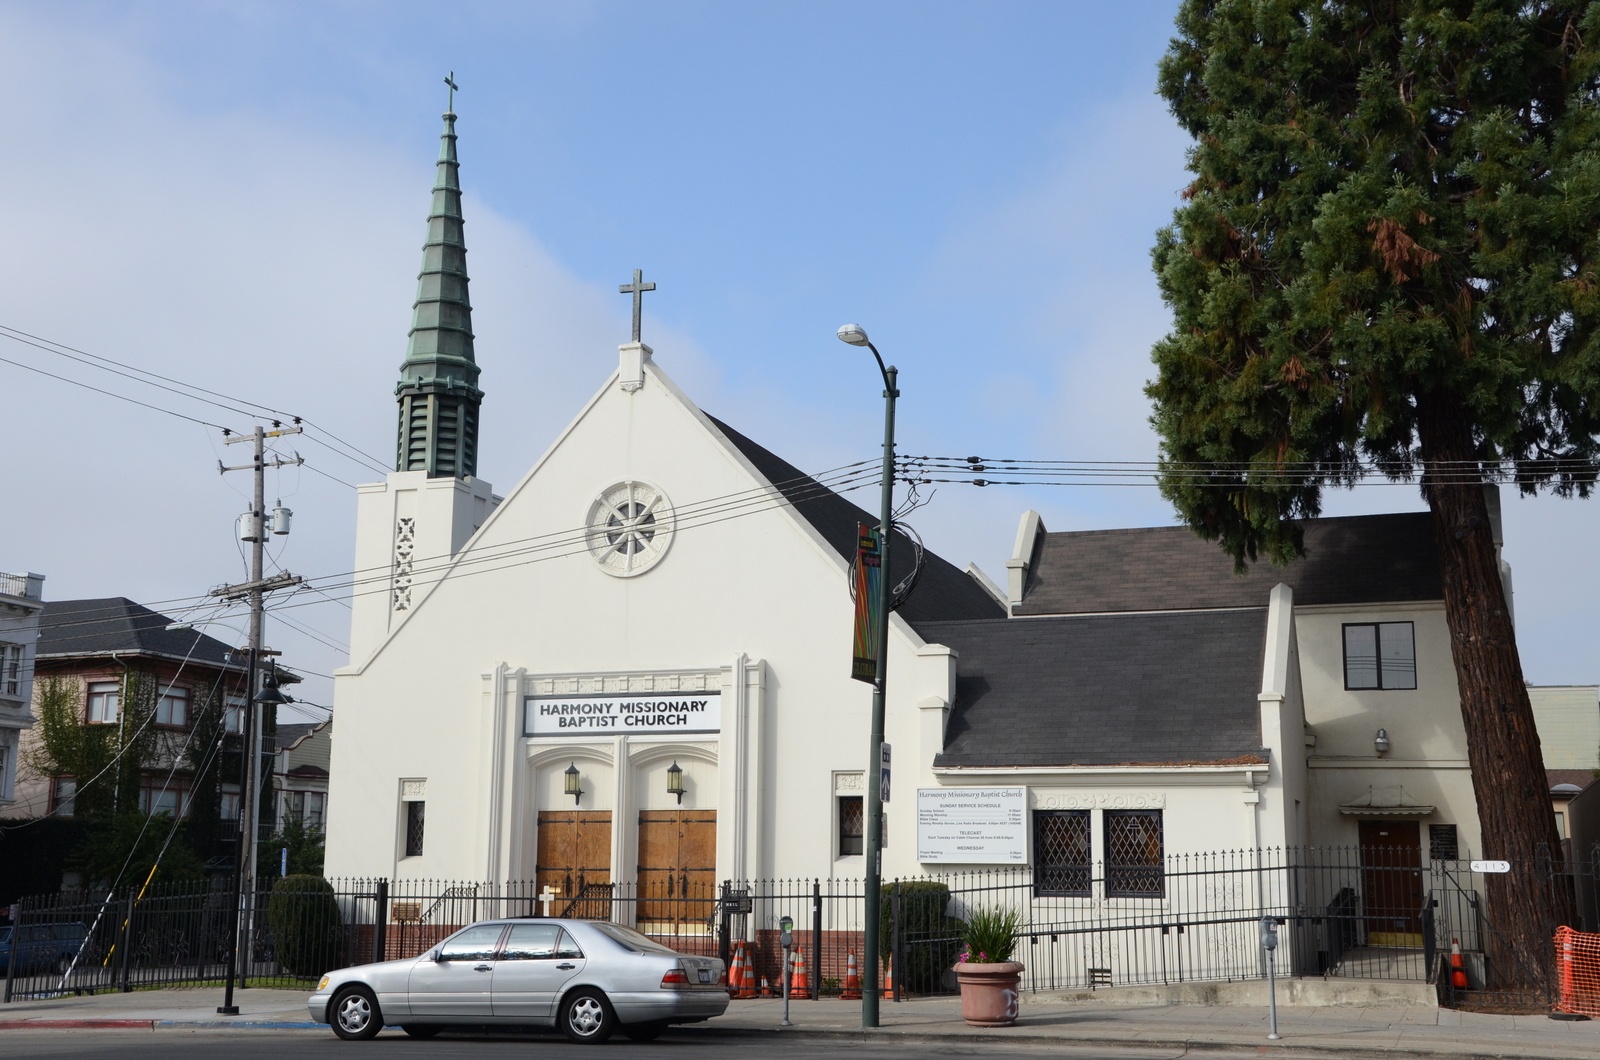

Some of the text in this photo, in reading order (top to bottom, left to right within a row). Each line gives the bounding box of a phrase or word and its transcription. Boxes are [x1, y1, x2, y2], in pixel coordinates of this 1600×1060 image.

[540, 700, 708, 716] HARMONY MISSIONARY
[559, 714, 687, 728] BAPTIST CHURCH
[948, 791, 979, 800] Missionary
[1001, 789, 1022, 798] Church
